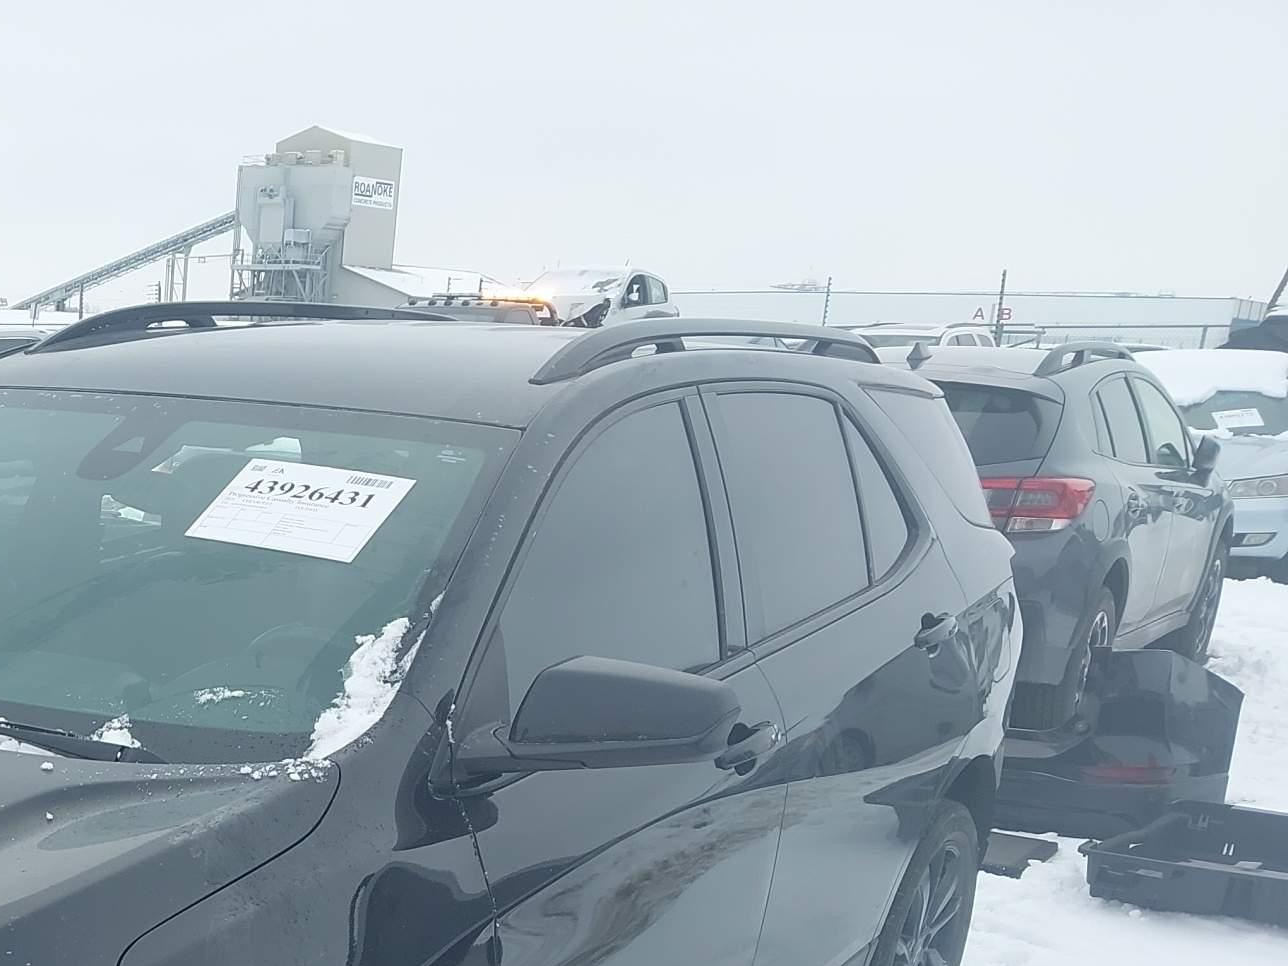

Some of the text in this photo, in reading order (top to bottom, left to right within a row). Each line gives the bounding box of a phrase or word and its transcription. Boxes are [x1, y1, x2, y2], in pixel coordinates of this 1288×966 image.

[354, 181, 393, 198] ROANOKE
[972, 307, 1012, 320] A B
[244, 478, 376, 509] 43926431
